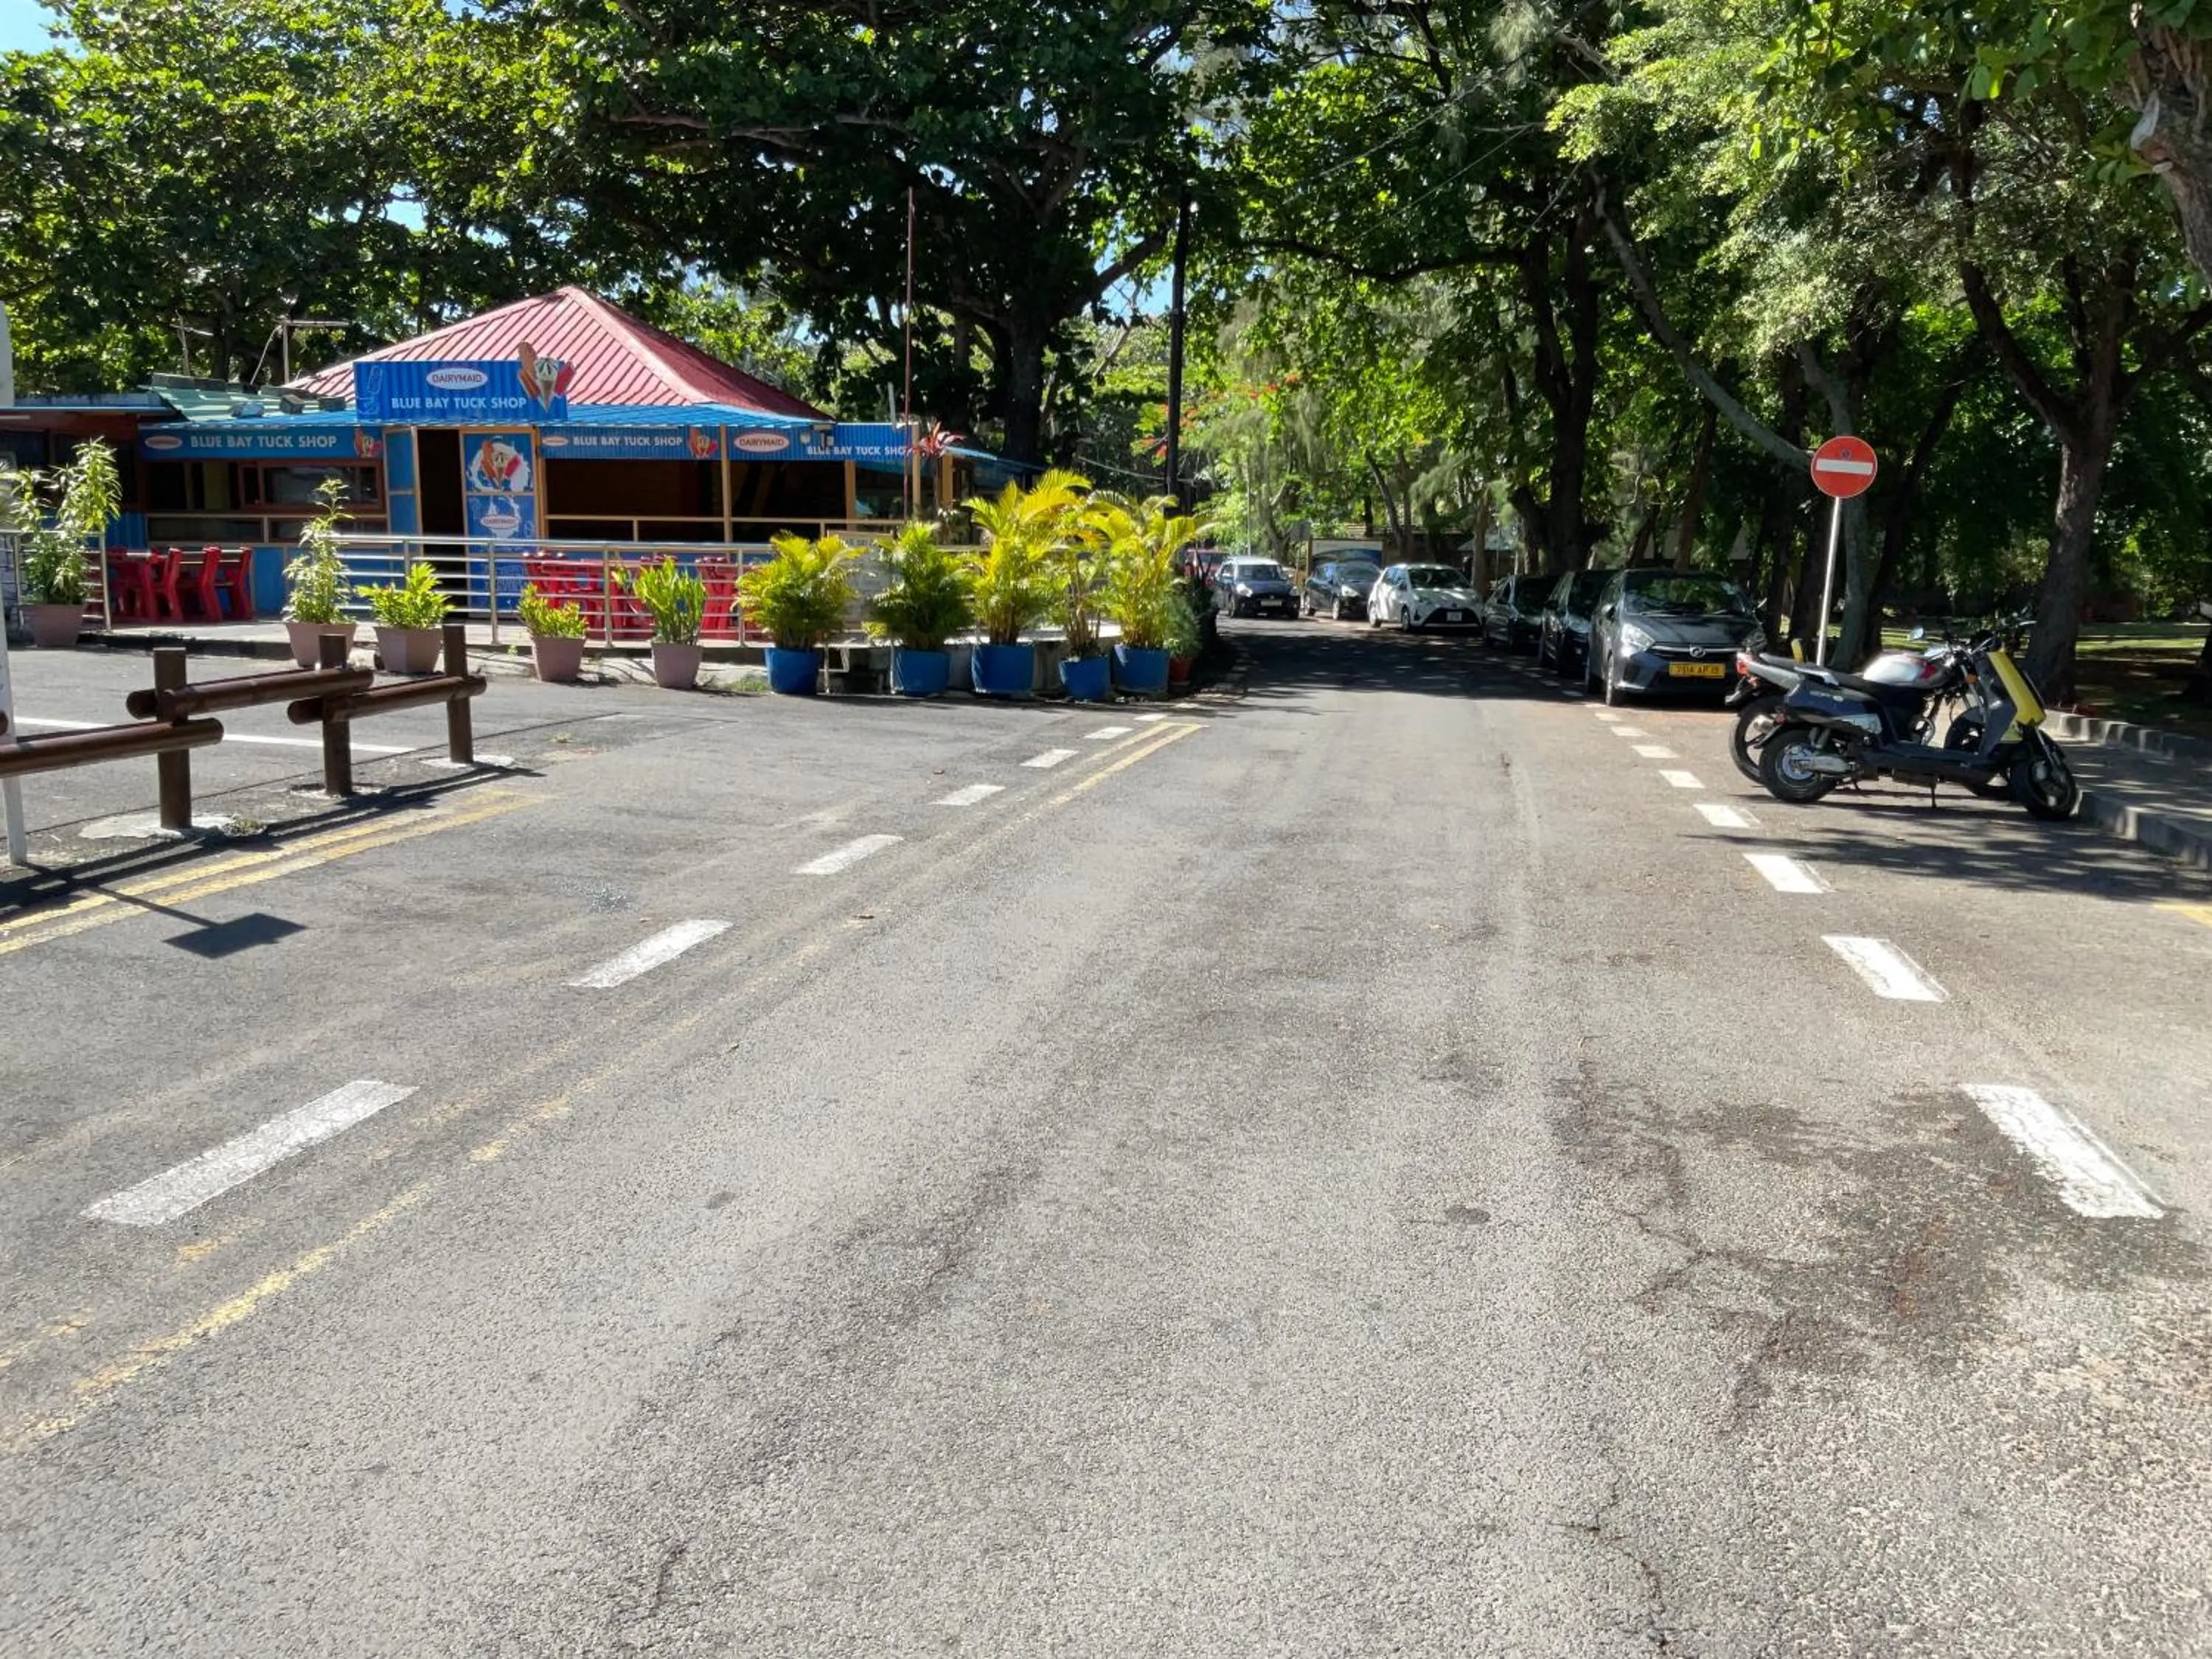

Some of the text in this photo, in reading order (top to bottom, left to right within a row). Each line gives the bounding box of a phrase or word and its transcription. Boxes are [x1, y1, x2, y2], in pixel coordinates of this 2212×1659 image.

[432, 374, 482, 383] DAIRYMAID
[392, 397, 527, 408] BLUE BAY TUCK SHOP
[190, 436, 223, 448] BLUE
[227, 436, 253, 448] BAY
[257, 436, 293, 448] TUCK
[299, 436, 337, 448] SHOP
[573, 436, 597, 445] BLUE
[601, 436, 621, 445] BAY
[624, 436, 651, 446] TUCK
[654, 436, 683, 446] SHOP
[834, 446, 852, 454] BAY
[856, 446, 881, 455] TUCK
[885, 446, 911, 456] SHO
